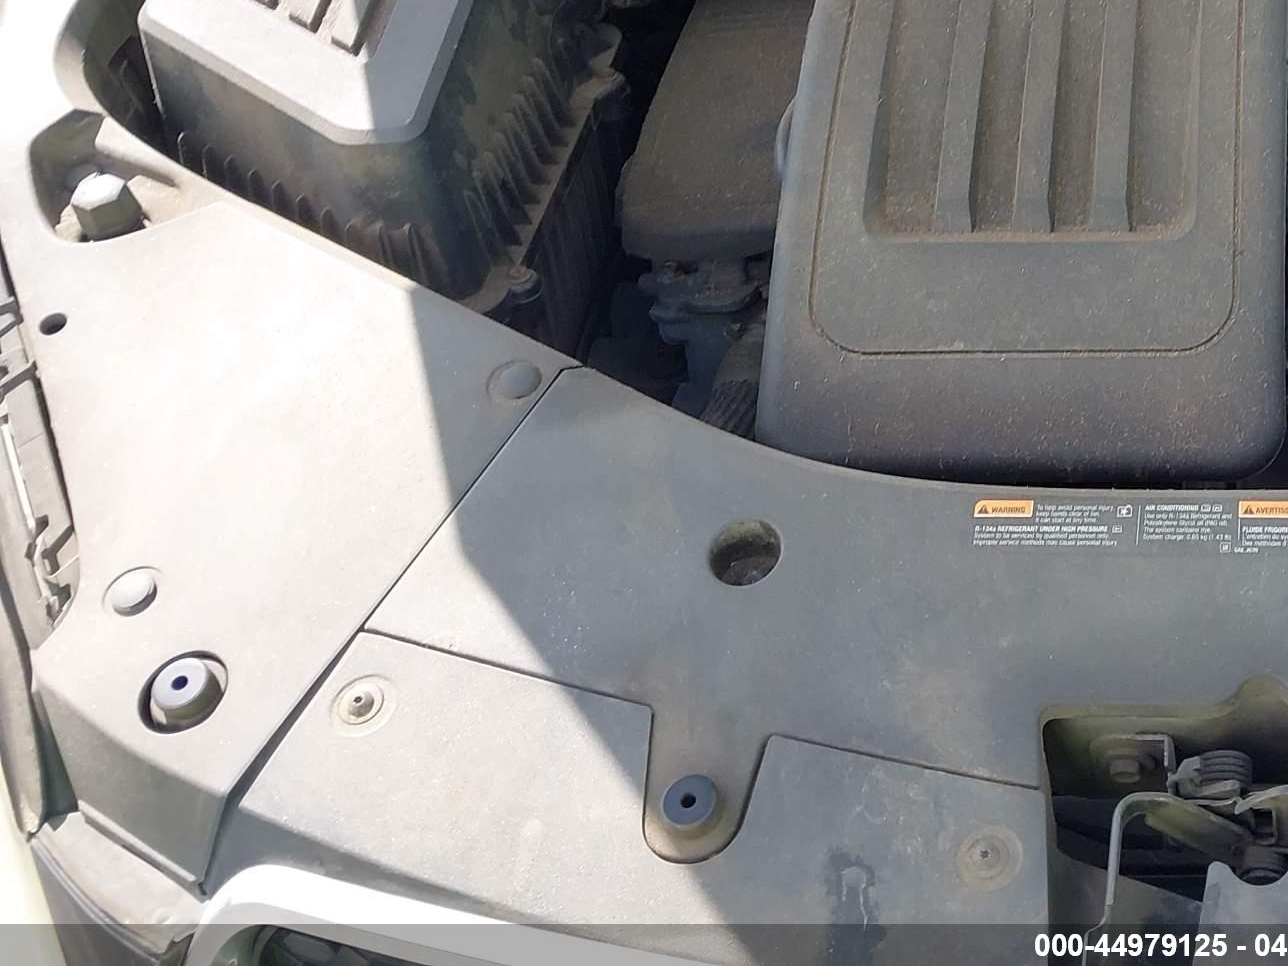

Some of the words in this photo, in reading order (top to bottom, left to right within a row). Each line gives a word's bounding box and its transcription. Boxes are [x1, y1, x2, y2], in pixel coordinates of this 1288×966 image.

[991, 506, 1026, 514] WARNING
[1073, 504, 1095, 513] personal
[1145, 504, 1156, 512] AIR
[997, 525, 1038, 533] REFRIGERANT
[1039, 525, 1060, 533] UNDER
[1061, 525, 1076, 533] HIGH
[1077, 525, 1108, 533] PRESSURE
[1242, 526, 1263, 534] FLUIDE
